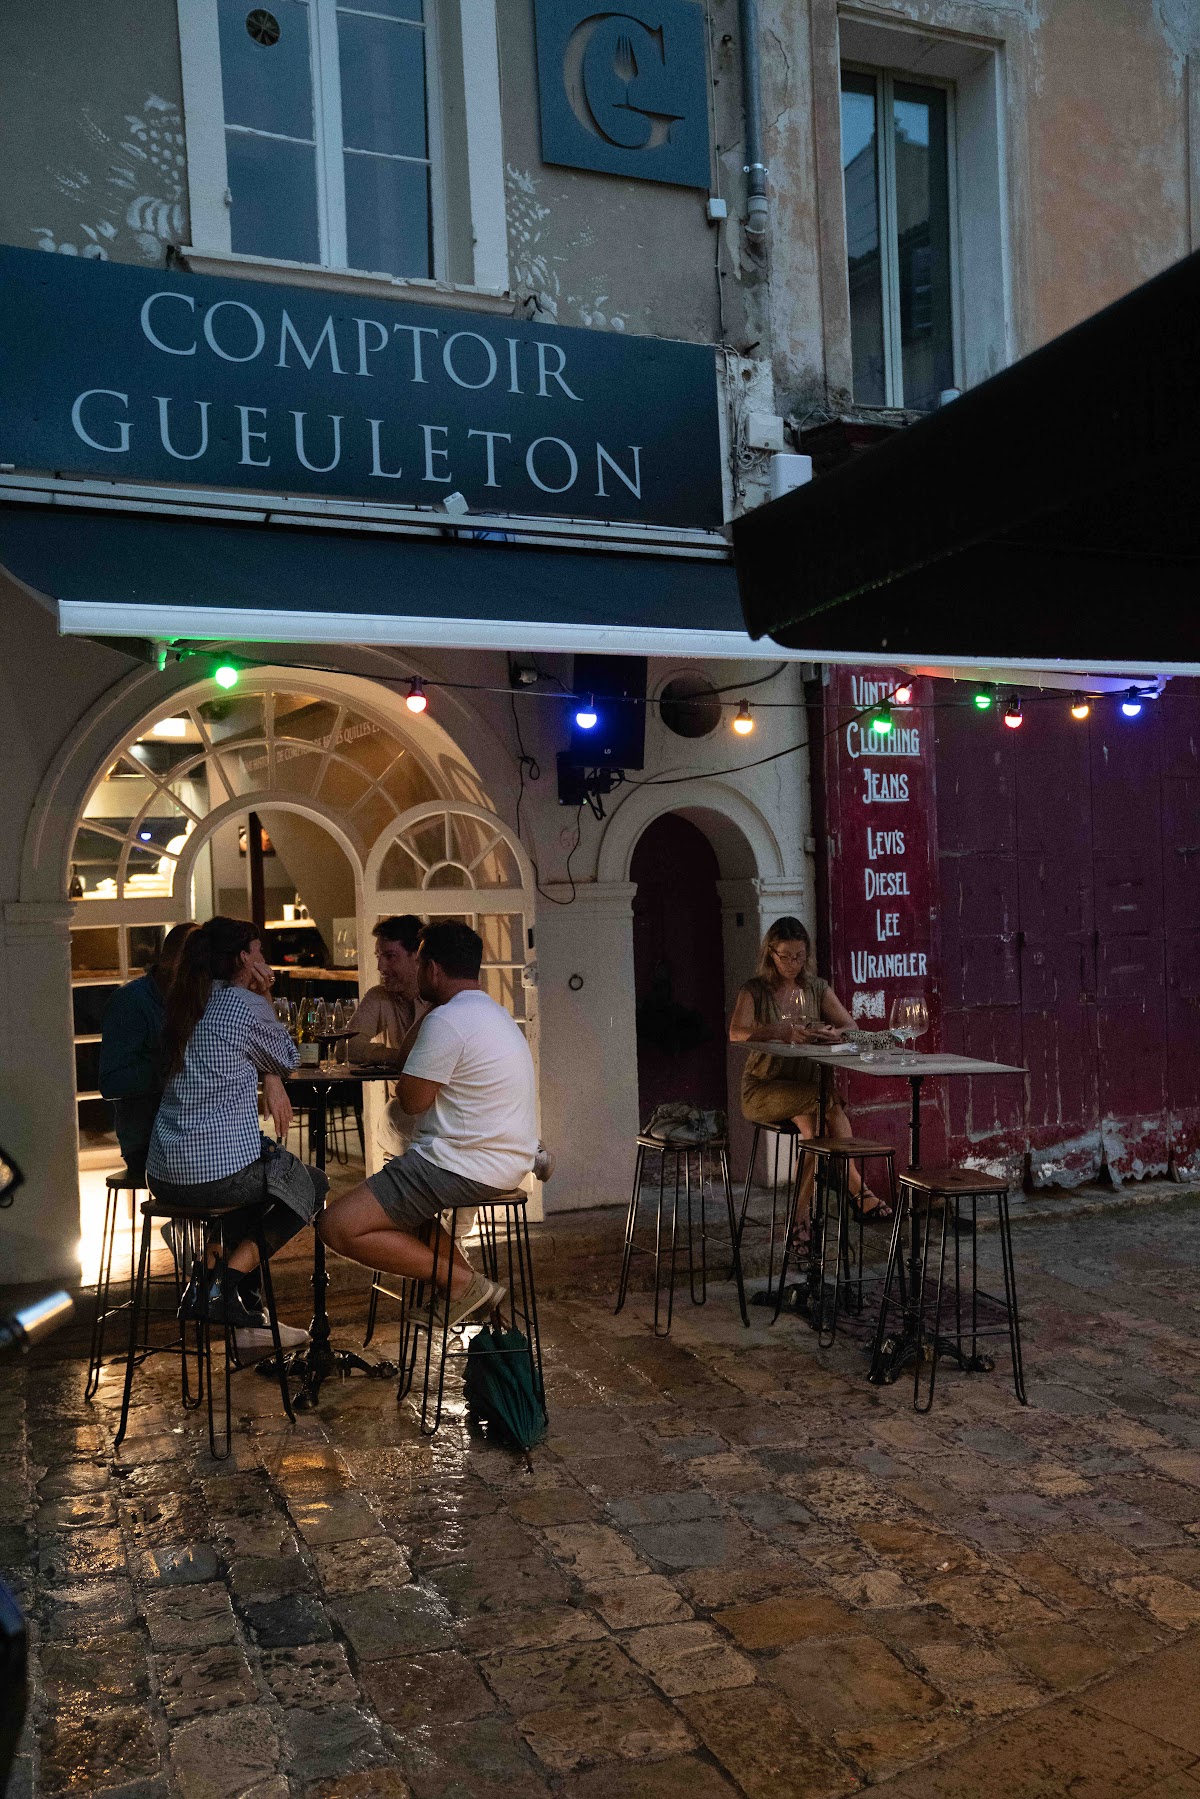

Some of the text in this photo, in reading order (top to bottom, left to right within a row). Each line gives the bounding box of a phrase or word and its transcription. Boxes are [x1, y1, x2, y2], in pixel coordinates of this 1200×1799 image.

[140, 291, 584, 401] COMPTOIR
[71, 388, 643, 500] GUEULETON
[851, 675, 913, 711] VINTA
[846, 721, 920, 758] CLOTHING
[862, 768, 909, 804] JEANS
[864, 868, 910, 901] DIESEL
[877, 909, 900, 942] LEE
[851, 951, 927, 984] WRANGLER
